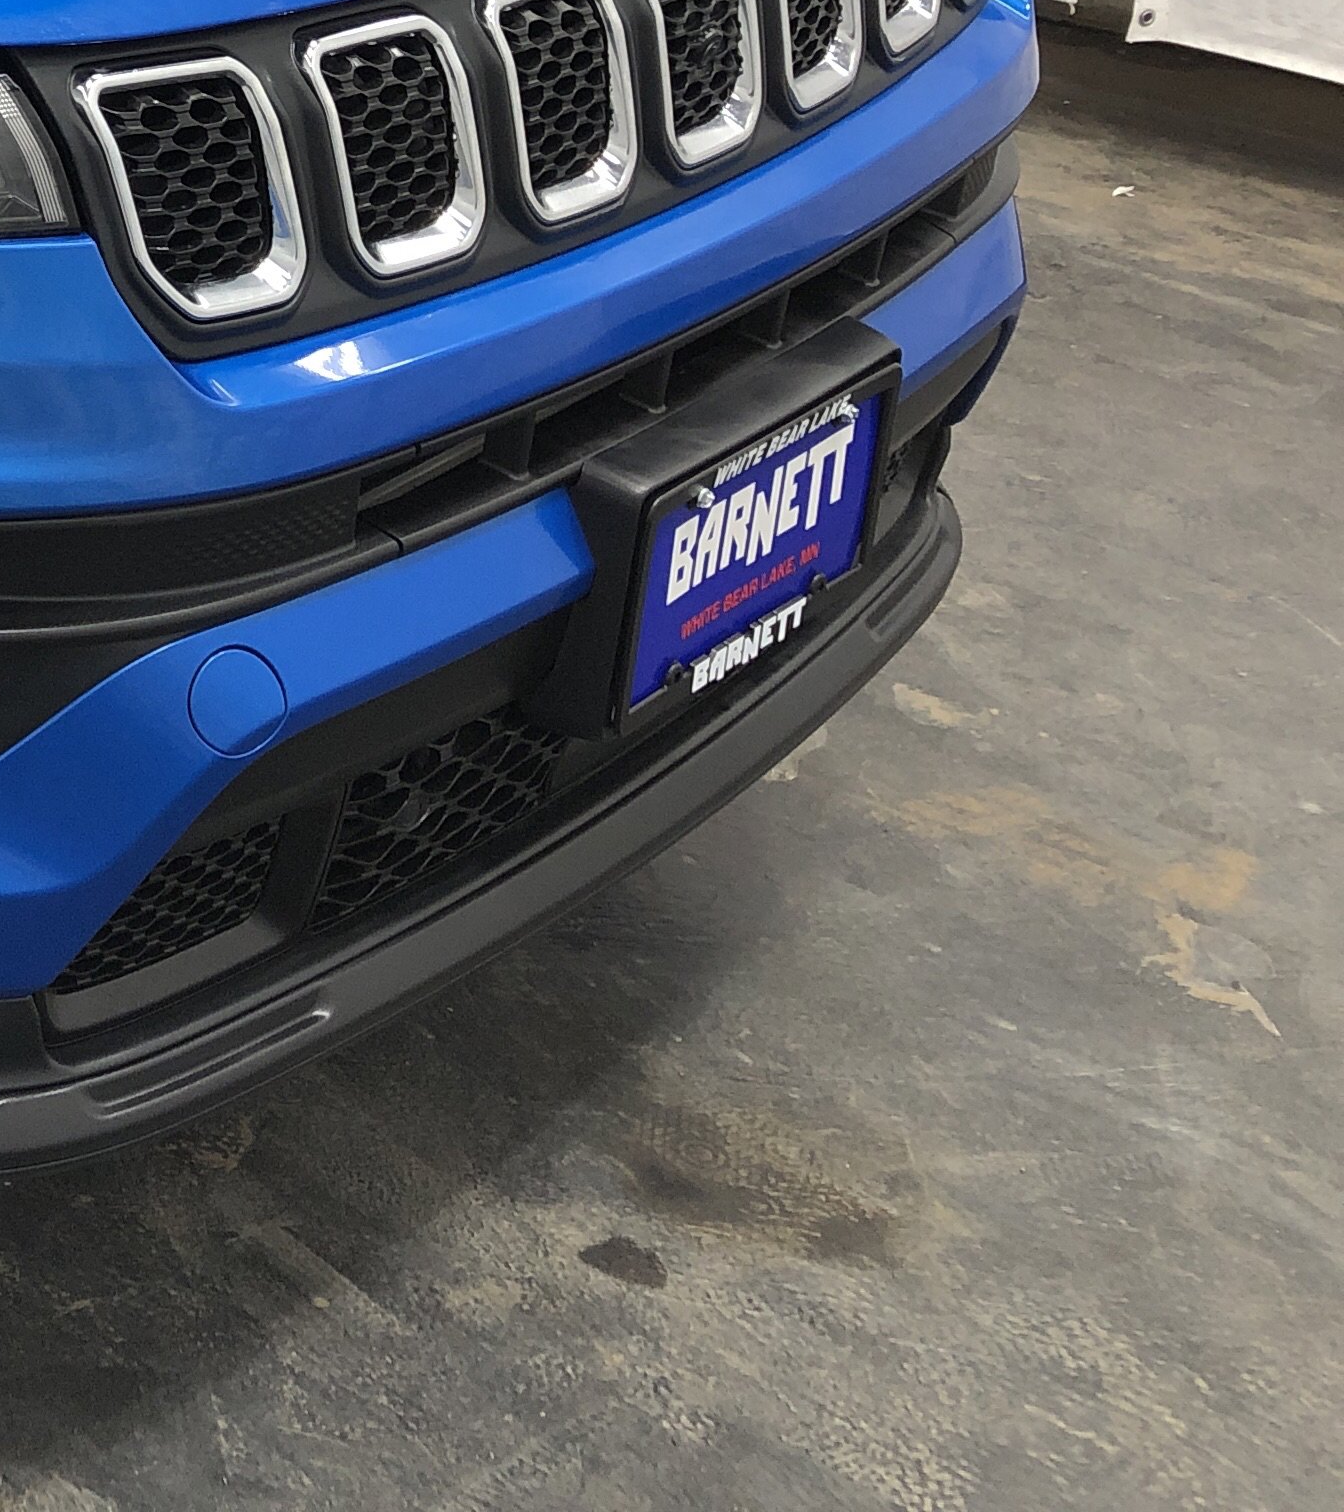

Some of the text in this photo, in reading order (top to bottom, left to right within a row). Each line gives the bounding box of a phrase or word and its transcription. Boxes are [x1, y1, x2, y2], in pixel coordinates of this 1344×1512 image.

[713, 394, 852, 488] WHITE BEAR LAKE
[666, 421, 855, 605] BARNETT
[681, 600, 721, 640] WHITE
[723, 577, 759, 612] BEAR
[691, 597, 808, 694] BARNETT
